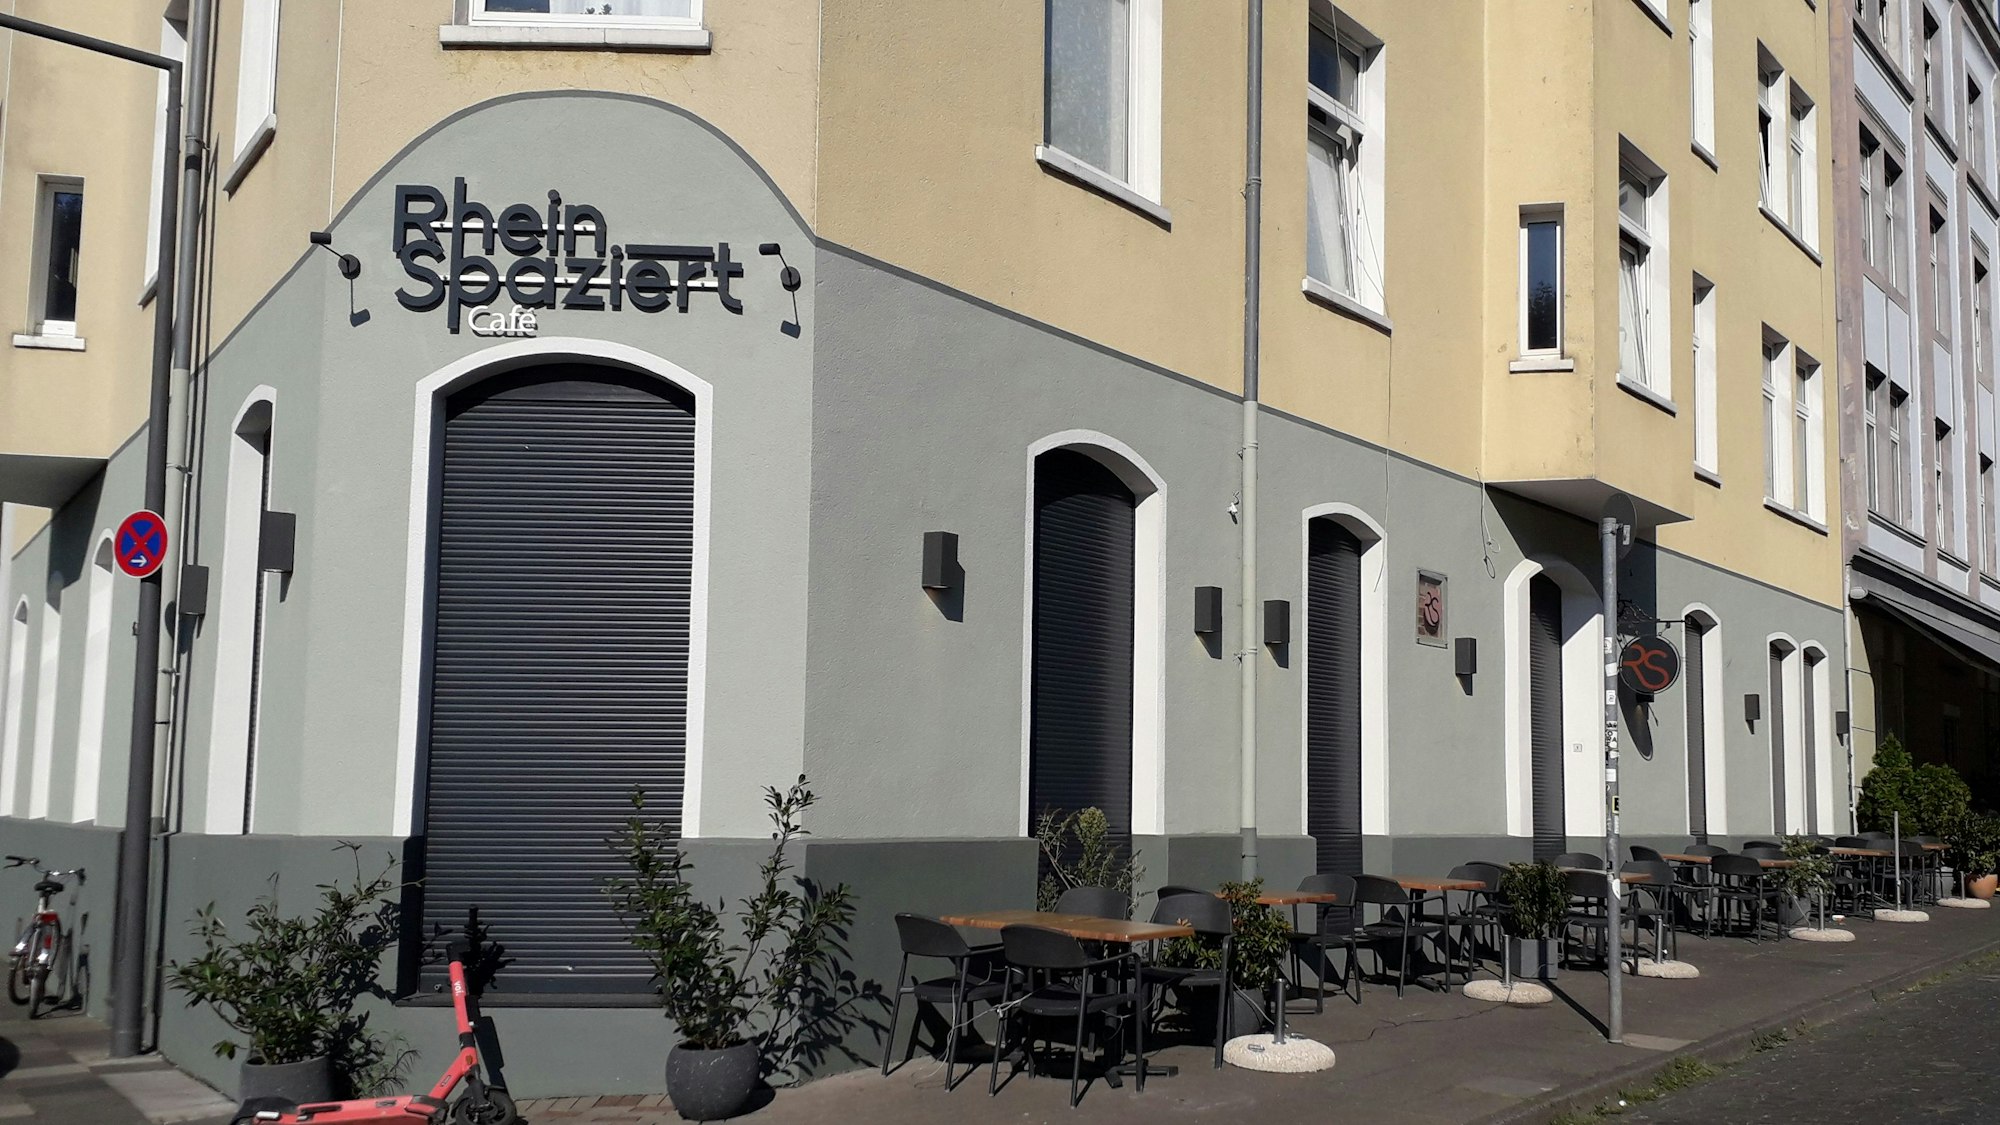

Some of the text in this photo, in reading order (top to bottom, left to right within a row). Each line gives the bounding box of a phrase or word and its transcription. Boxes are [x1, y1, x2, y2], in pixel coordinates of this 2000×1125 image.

[394, 177, 606, 257] Rhein
[395, 240, 743, 333] Spaziert
[467, 305, 536, 333] Café
